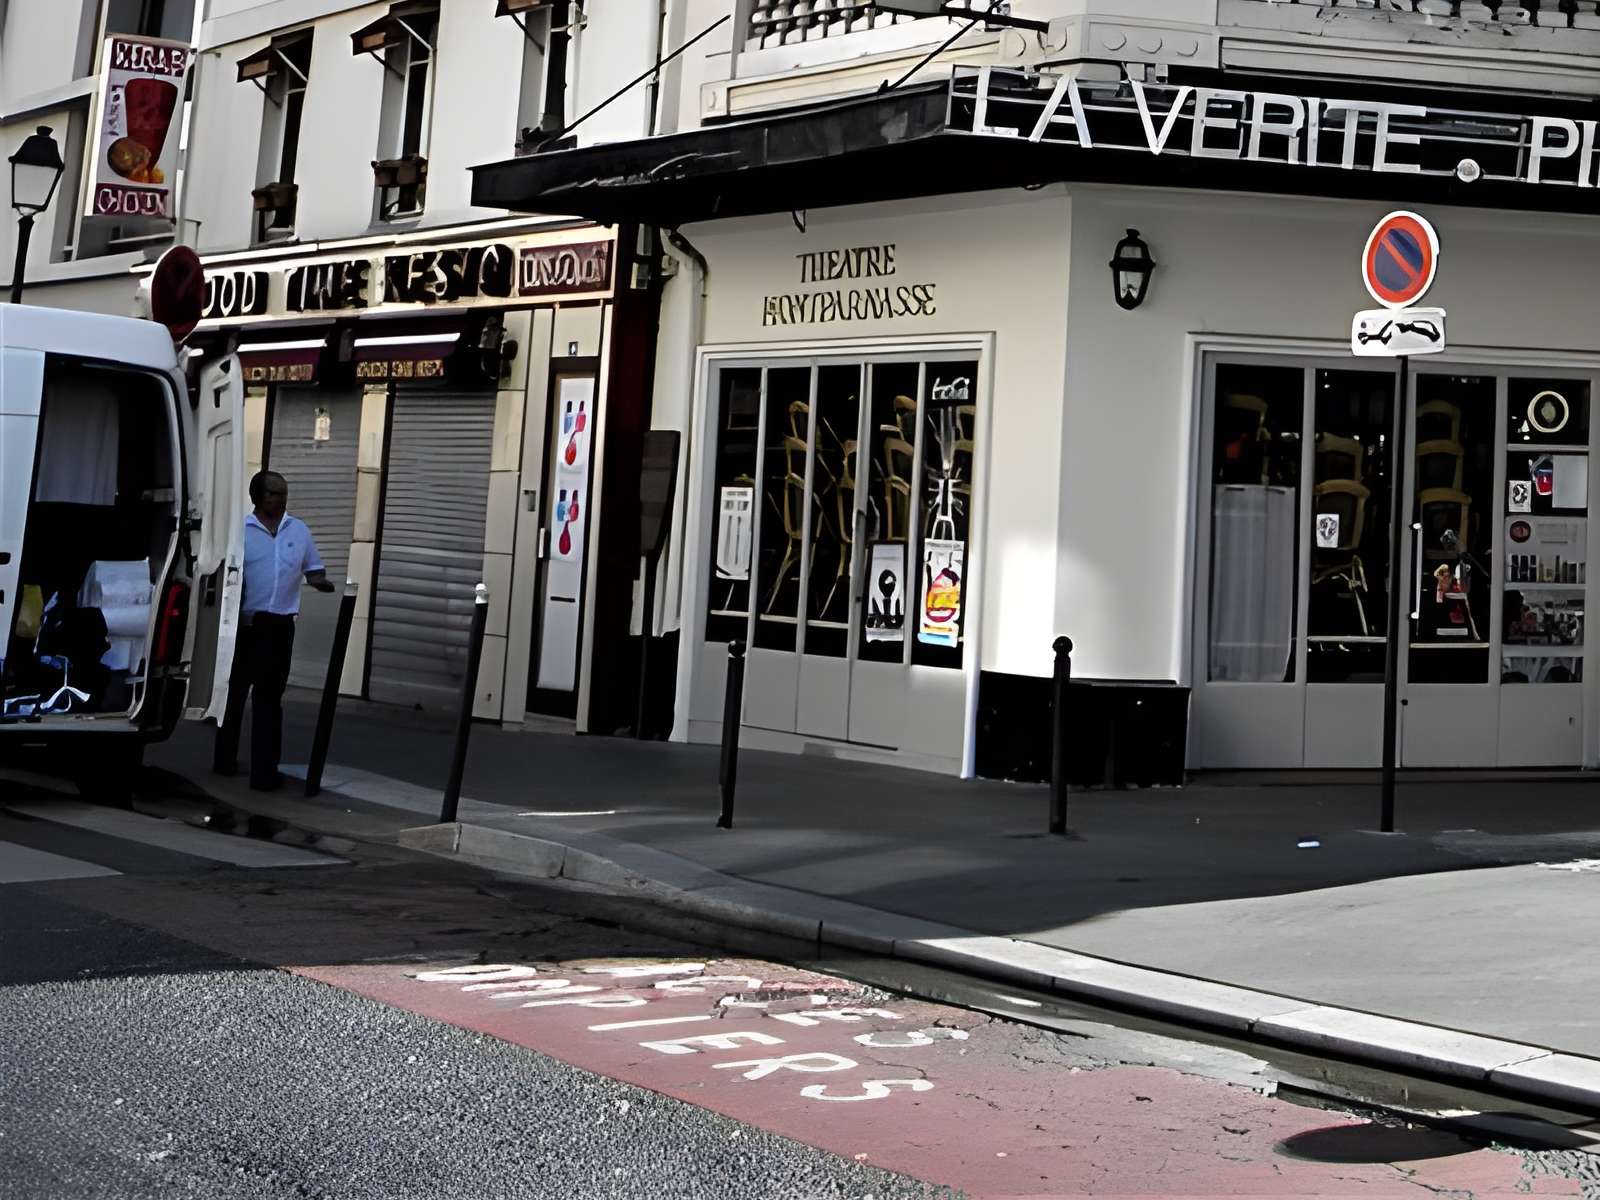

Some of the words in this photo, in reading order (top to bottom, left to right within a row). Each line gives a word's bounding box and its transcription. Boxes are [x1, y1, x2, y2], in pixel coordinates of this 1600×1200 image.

[972, 65, 1093, 148] LA
[1128, 78, 1427, 173] VERITE
[796, 244, 896, 283] THEATRE
